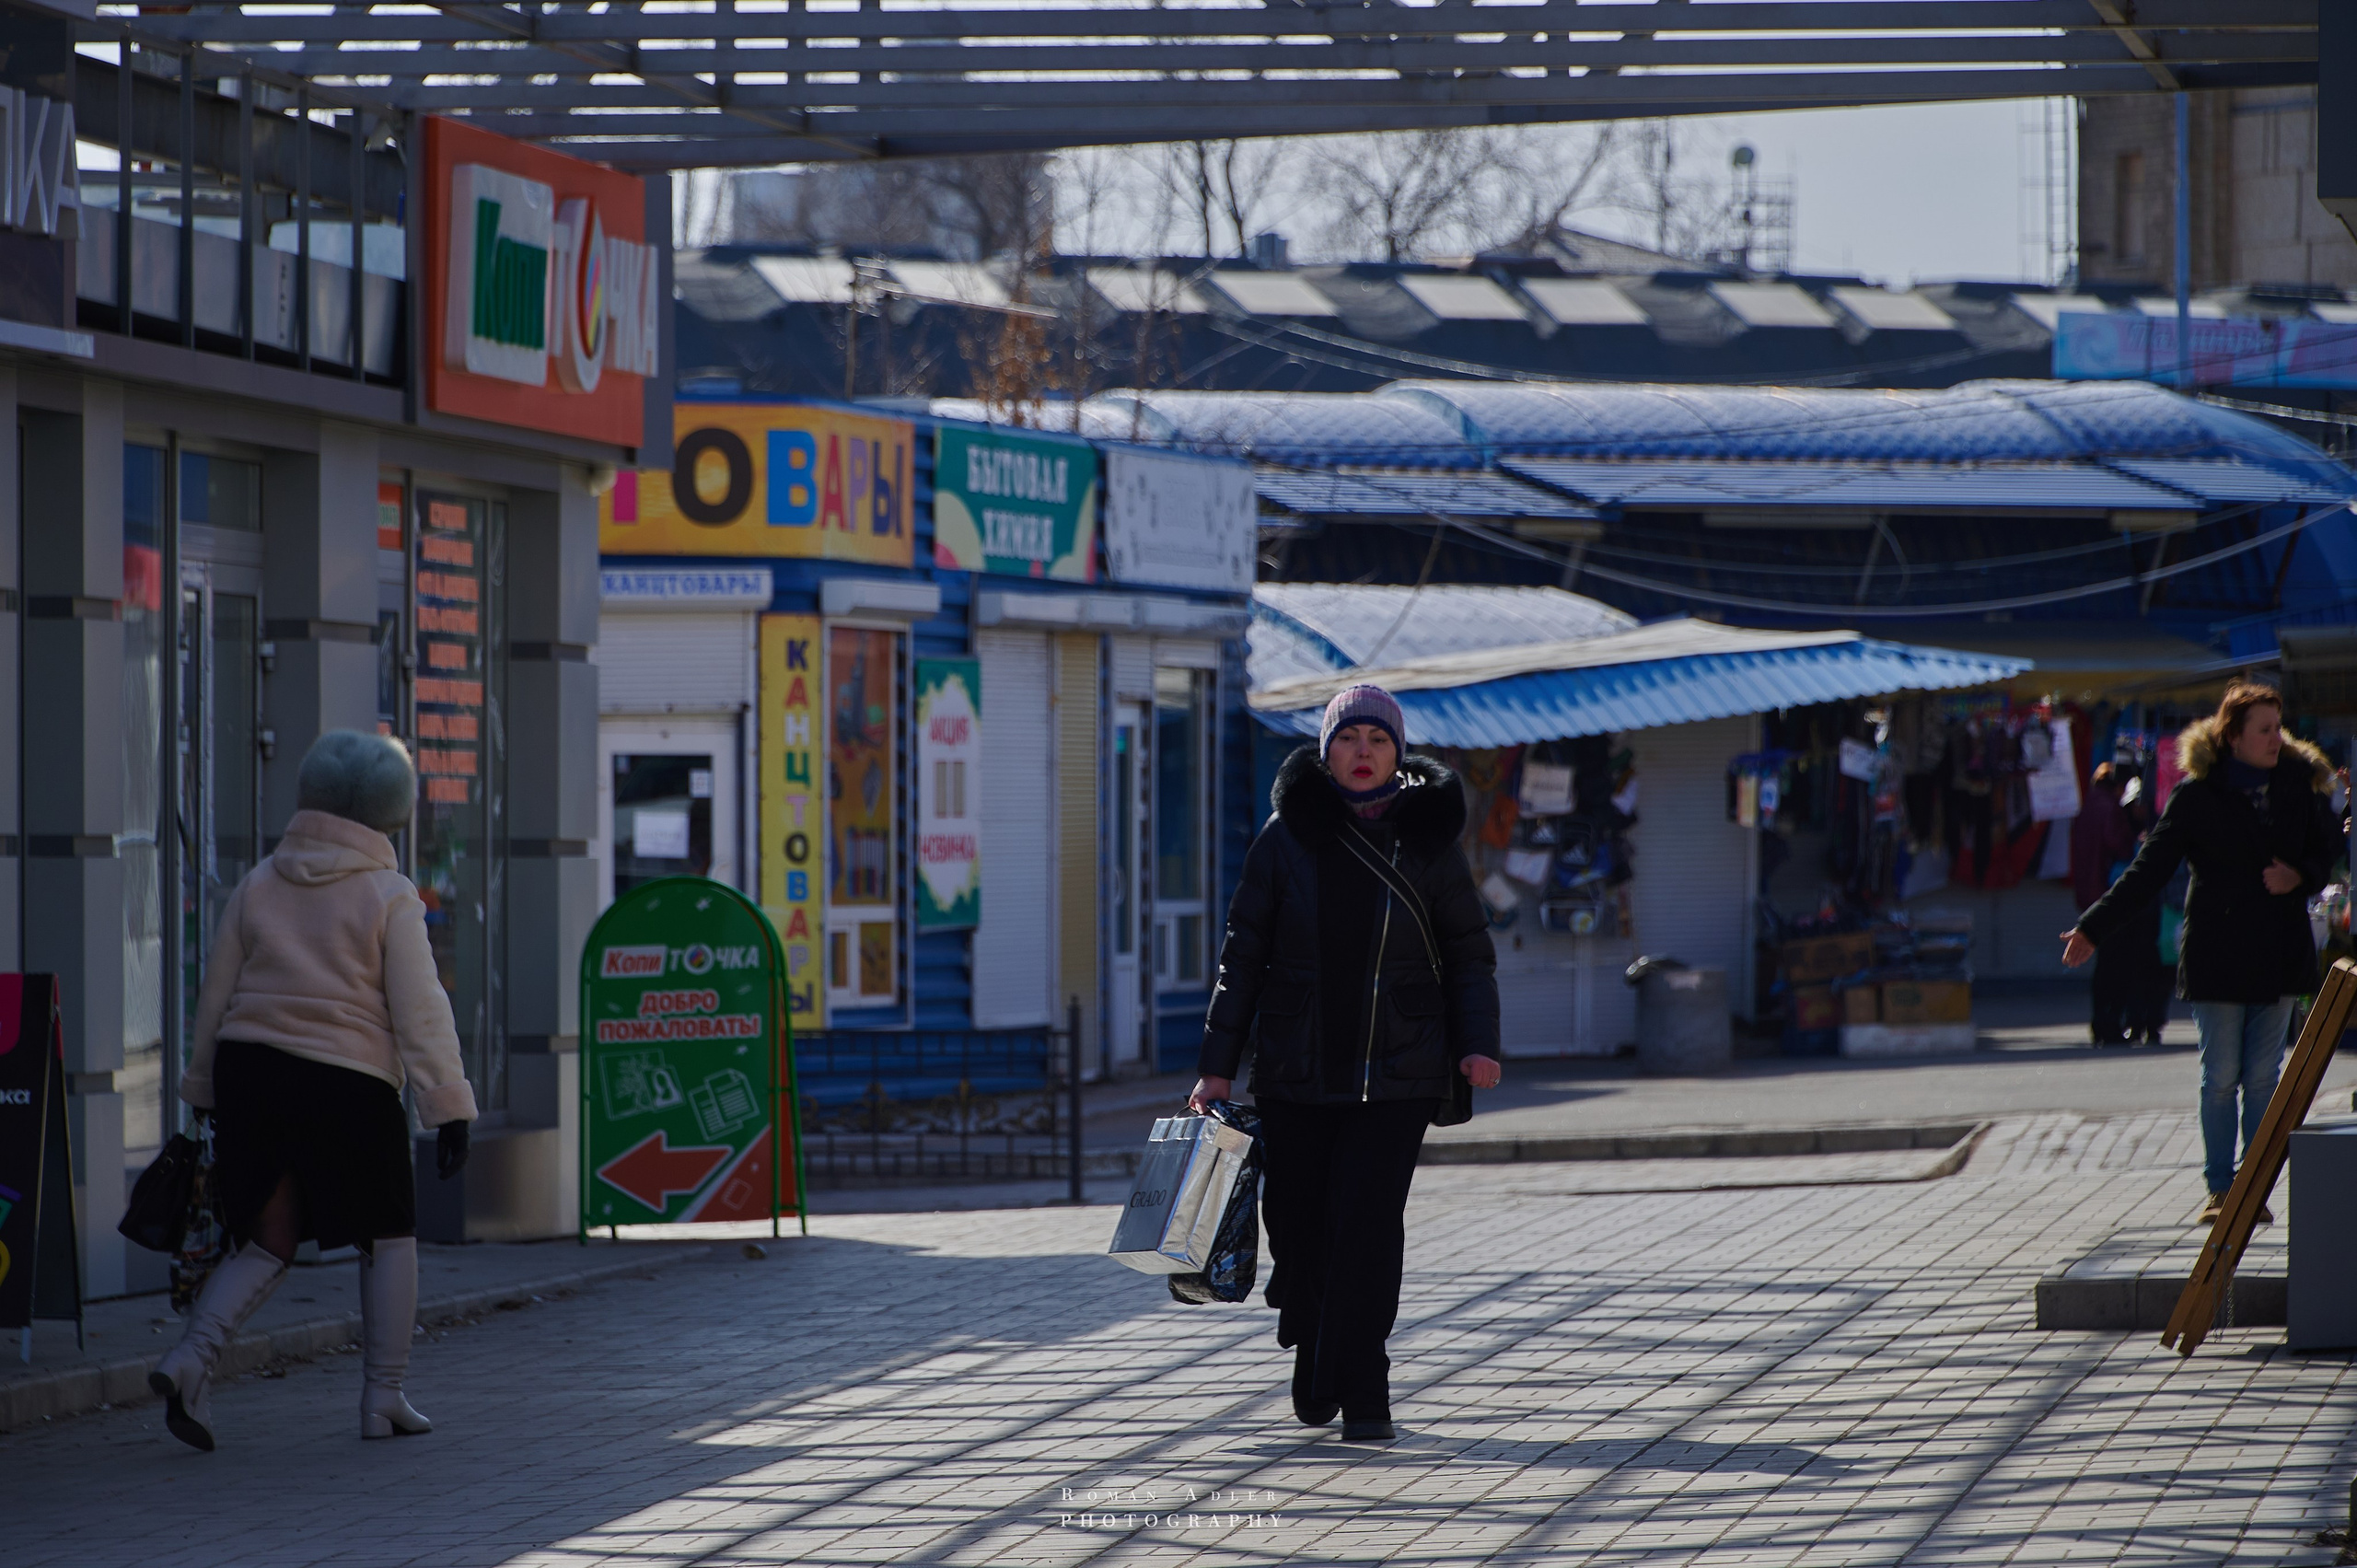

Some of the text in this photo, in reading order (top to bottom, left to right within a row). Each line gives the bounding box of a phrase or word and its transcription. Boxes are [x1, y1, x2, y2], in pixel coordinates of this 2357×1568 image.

[966, 444, 1069, 505] БЫТОВАЯ
[982, 508, 1054, 562] ХИМИЯ
[604, 574, 762, 598] КАНЦТОВАРЫ
[928, 715, 970, 749] АКЦИЯ
[605, 942, 761, 976] Копи ТОЧКА
[639, 990, 718, 1017] ДОБРО
[598, 1016, 760, 1042] ПОЖАЛОВАТЬ!
[1130, 1189, 1167, 1208] GRADO
